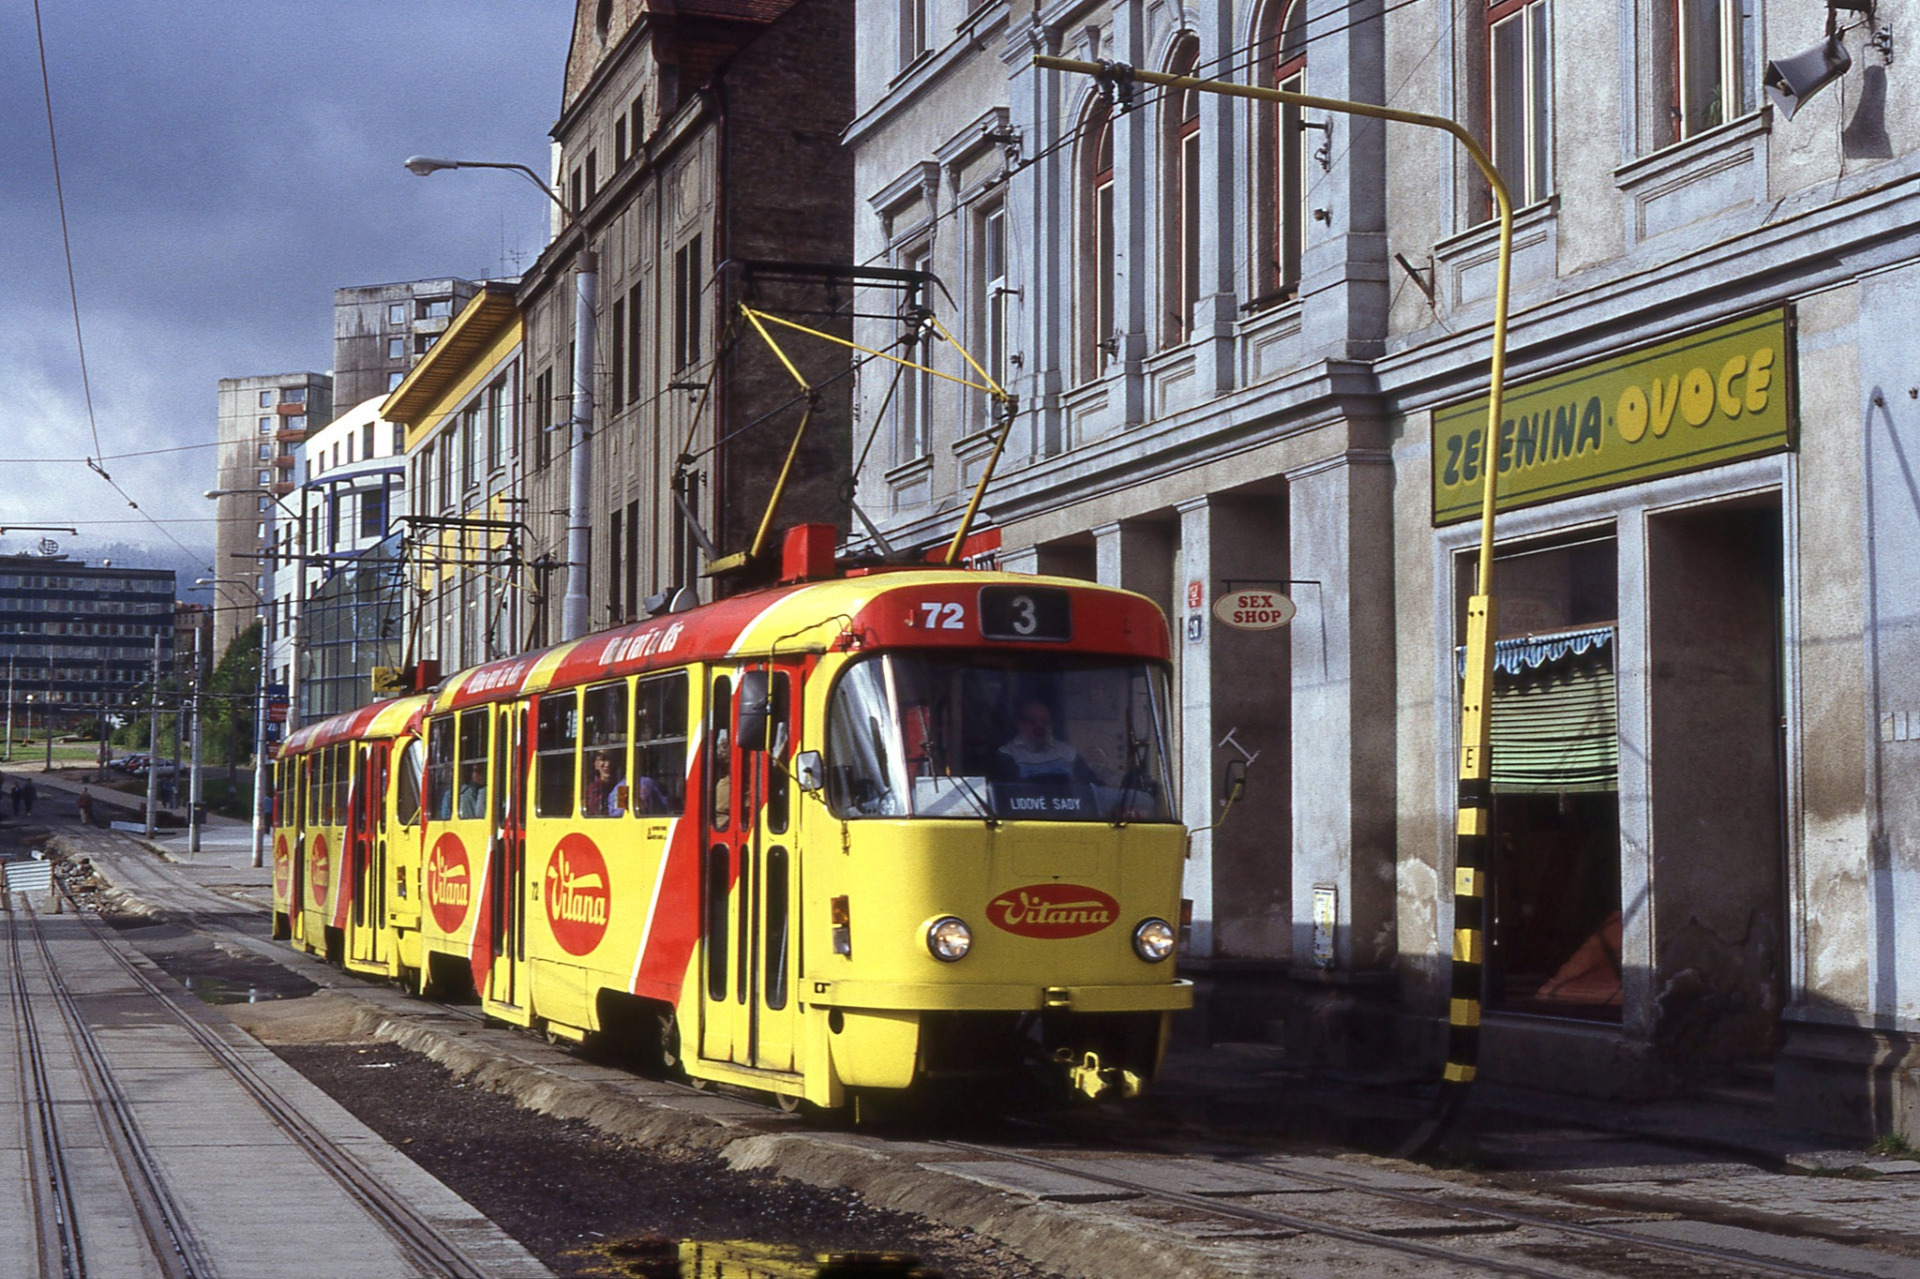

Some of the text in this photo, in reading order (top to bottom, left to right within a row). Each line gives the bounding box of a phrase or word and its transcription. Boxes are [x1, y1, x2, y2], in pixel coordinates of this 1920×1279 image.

[1616, 347, 1775, 443] OVOCE
[921, 602, 965, 629] 72
[1012, 596, 1037, 635] 3
[1233, 610, 1281, 623] SHOP
[1238, 595, 1273, 608] SEX
[1466, 748, 1474, 768] E
[1010, 796, 1081, 810] LIDOVÉ SADY
[429, 846, 468, 906] Vitana
[547, 849, 606, 926] Vitana
[994, 891, 1110, 925] Vitana
